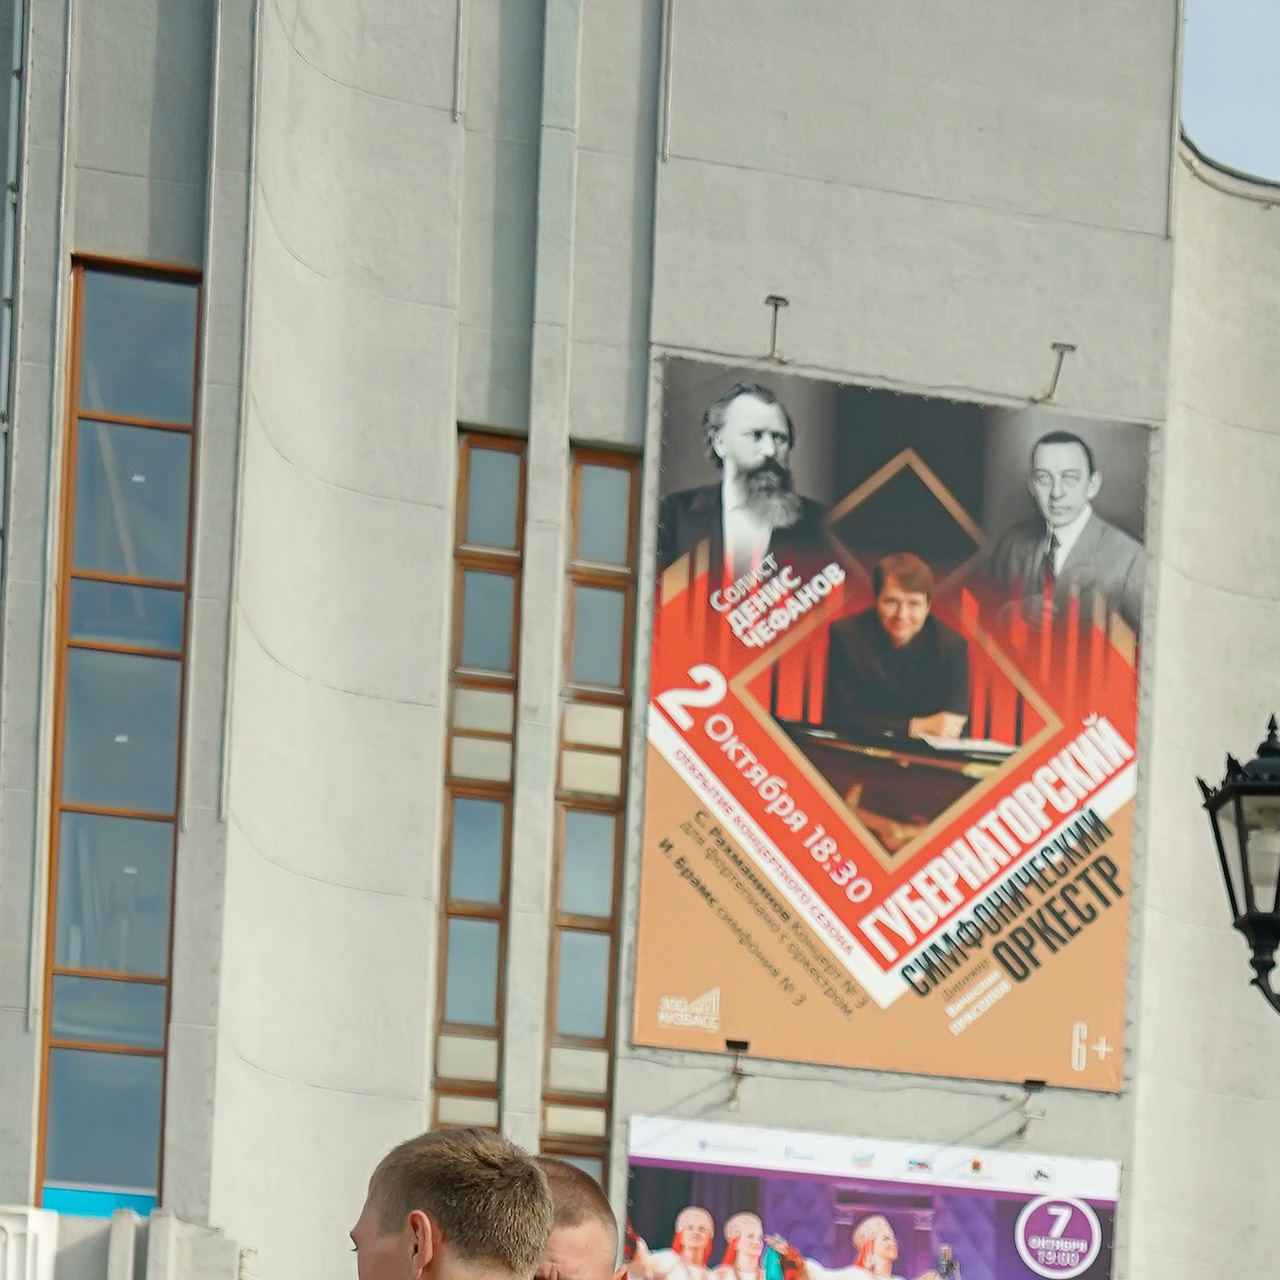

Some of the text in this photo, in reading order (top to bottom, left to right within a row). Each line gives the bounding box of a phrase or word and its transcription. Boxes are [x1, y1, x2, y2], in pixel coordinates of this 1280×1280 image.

[709, 552, 779, 612] Солист
[725, 564, 802, 637] ДЕНИС
[739, 561, 847, 648] ЧЕФАНОВ
[655, 663, 873, 903] 2 Октября 18:30
[674, 749, 854, 955] ОТКРЫТИЕ КОНЦЕРТНОГО СЕЗОНА
[674, 856, 718, 908] Брамс
[710, 826, 789, 922] Рахманинов
[857, 711, 1135, 963] ГУБЕРНАТОРСКИЙ
[900, 804, 1114, 998] СИМФОНИЧЕСКИЙ
[992, 854, 1125, 984] ОРКЕСТР
[1071, 1021, 1114, 1072] 6+
[1047, 1205, 1072, 1238] 7
